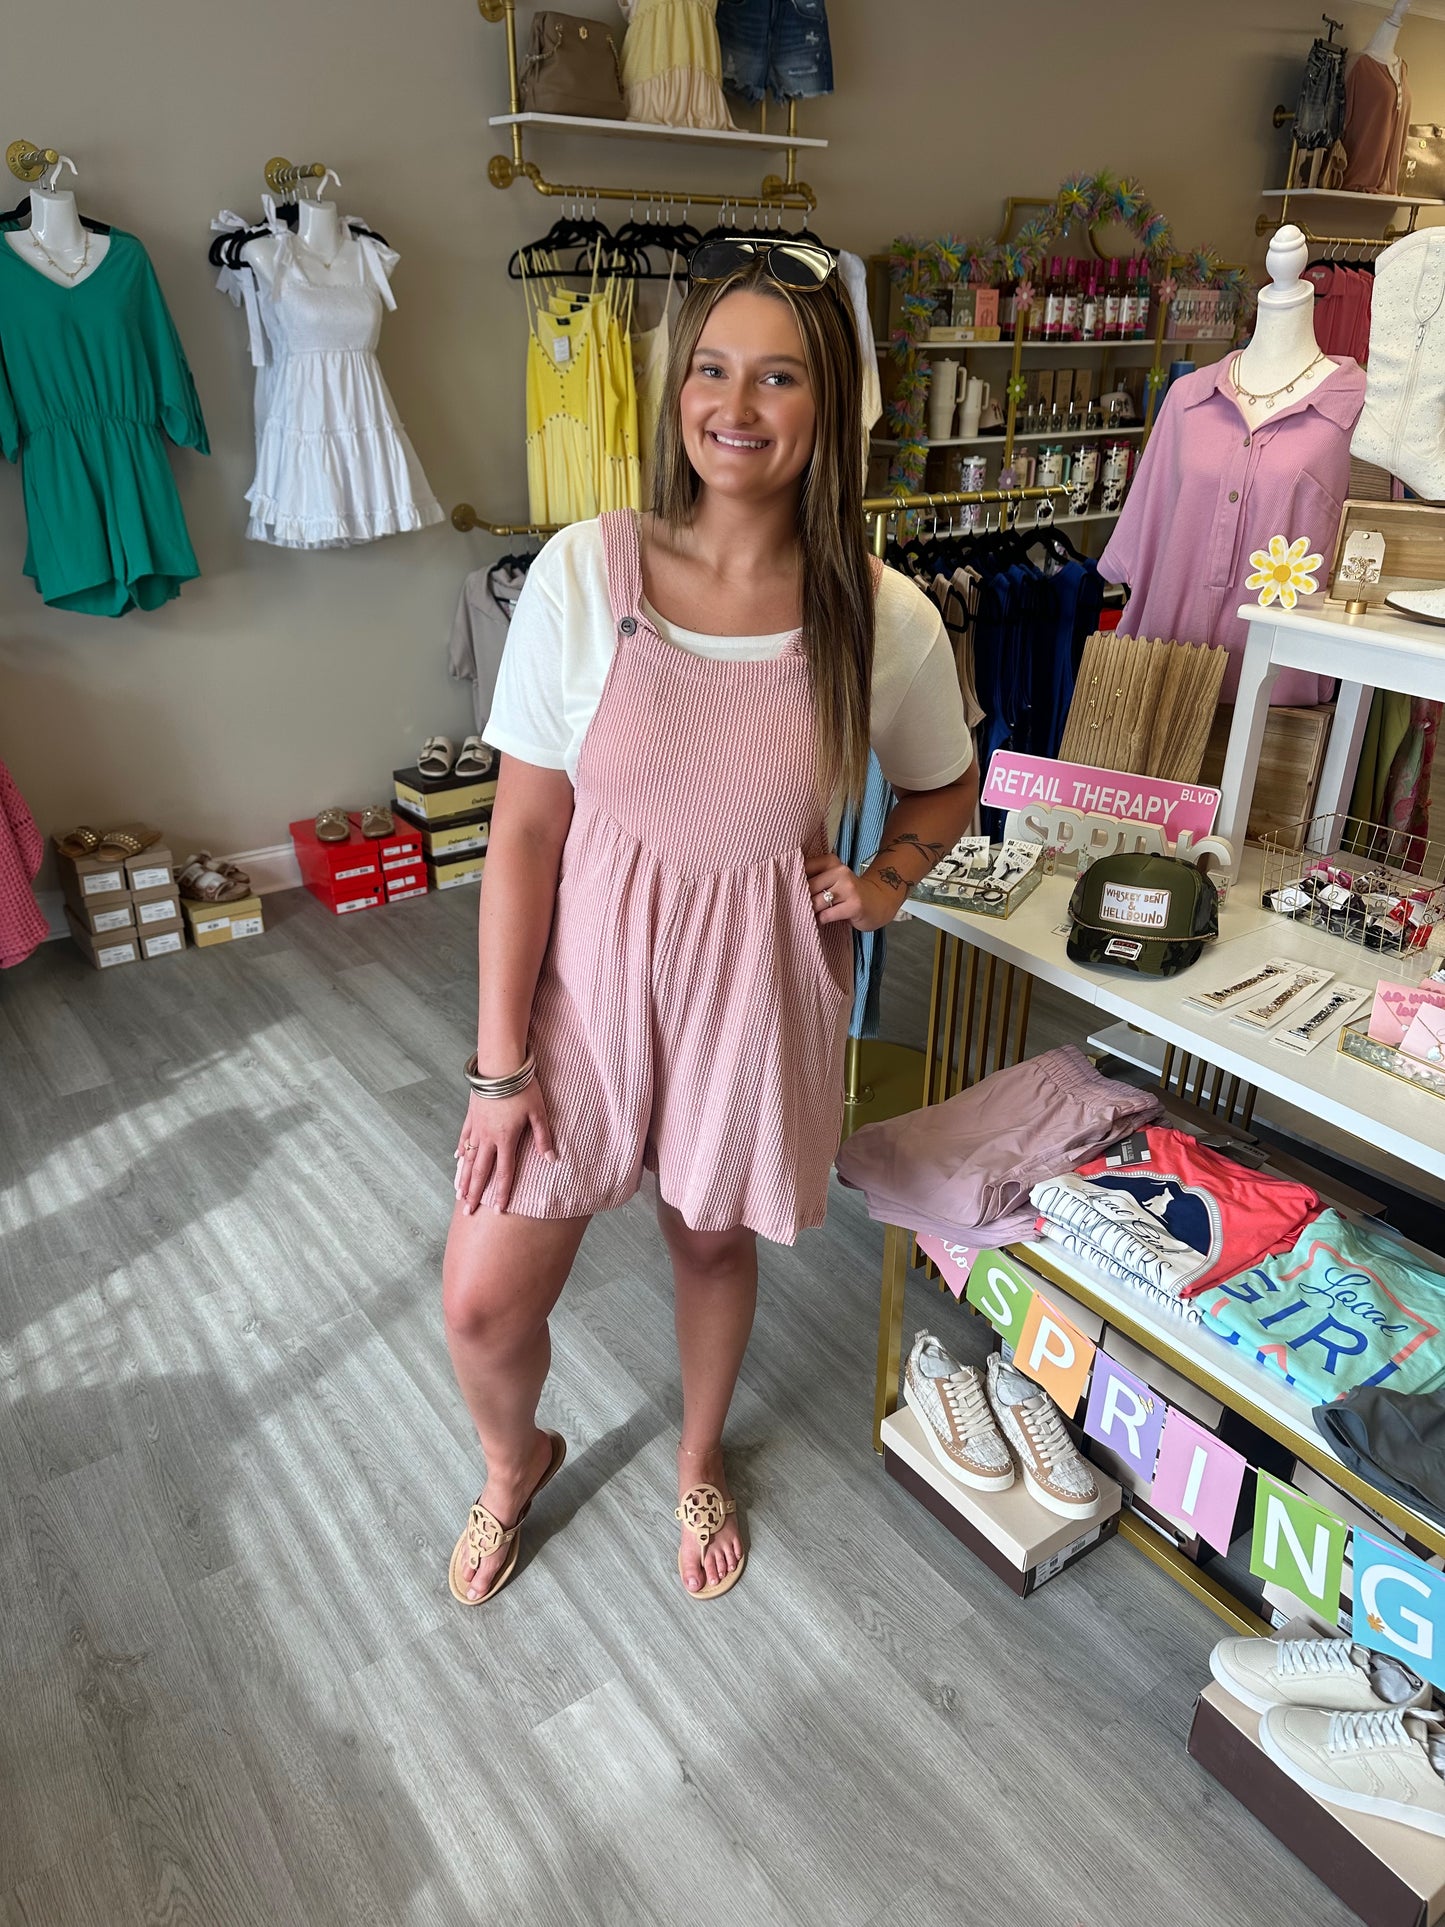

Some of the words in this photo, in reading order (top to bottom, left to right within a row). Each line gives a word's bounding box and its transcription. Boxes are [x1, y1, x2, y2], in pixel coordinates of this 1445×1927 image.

[990, 766, 1062, 803] RETAIL
[1072, 781, 1179, 825] THERAPY
[1180, 788, 1215, 806] BLVD
[1106, 888, 1141, 902] WHISKEY
[1144, 892, 1168, 904] BENT
[1128, 901, 1137, 911] &
[1103, 905, 1163, 925] HELLBOUND
[1036, 1186, 1173, 1290] OUTFITTERS
[1299, 1267, 1409, 1338] Local
